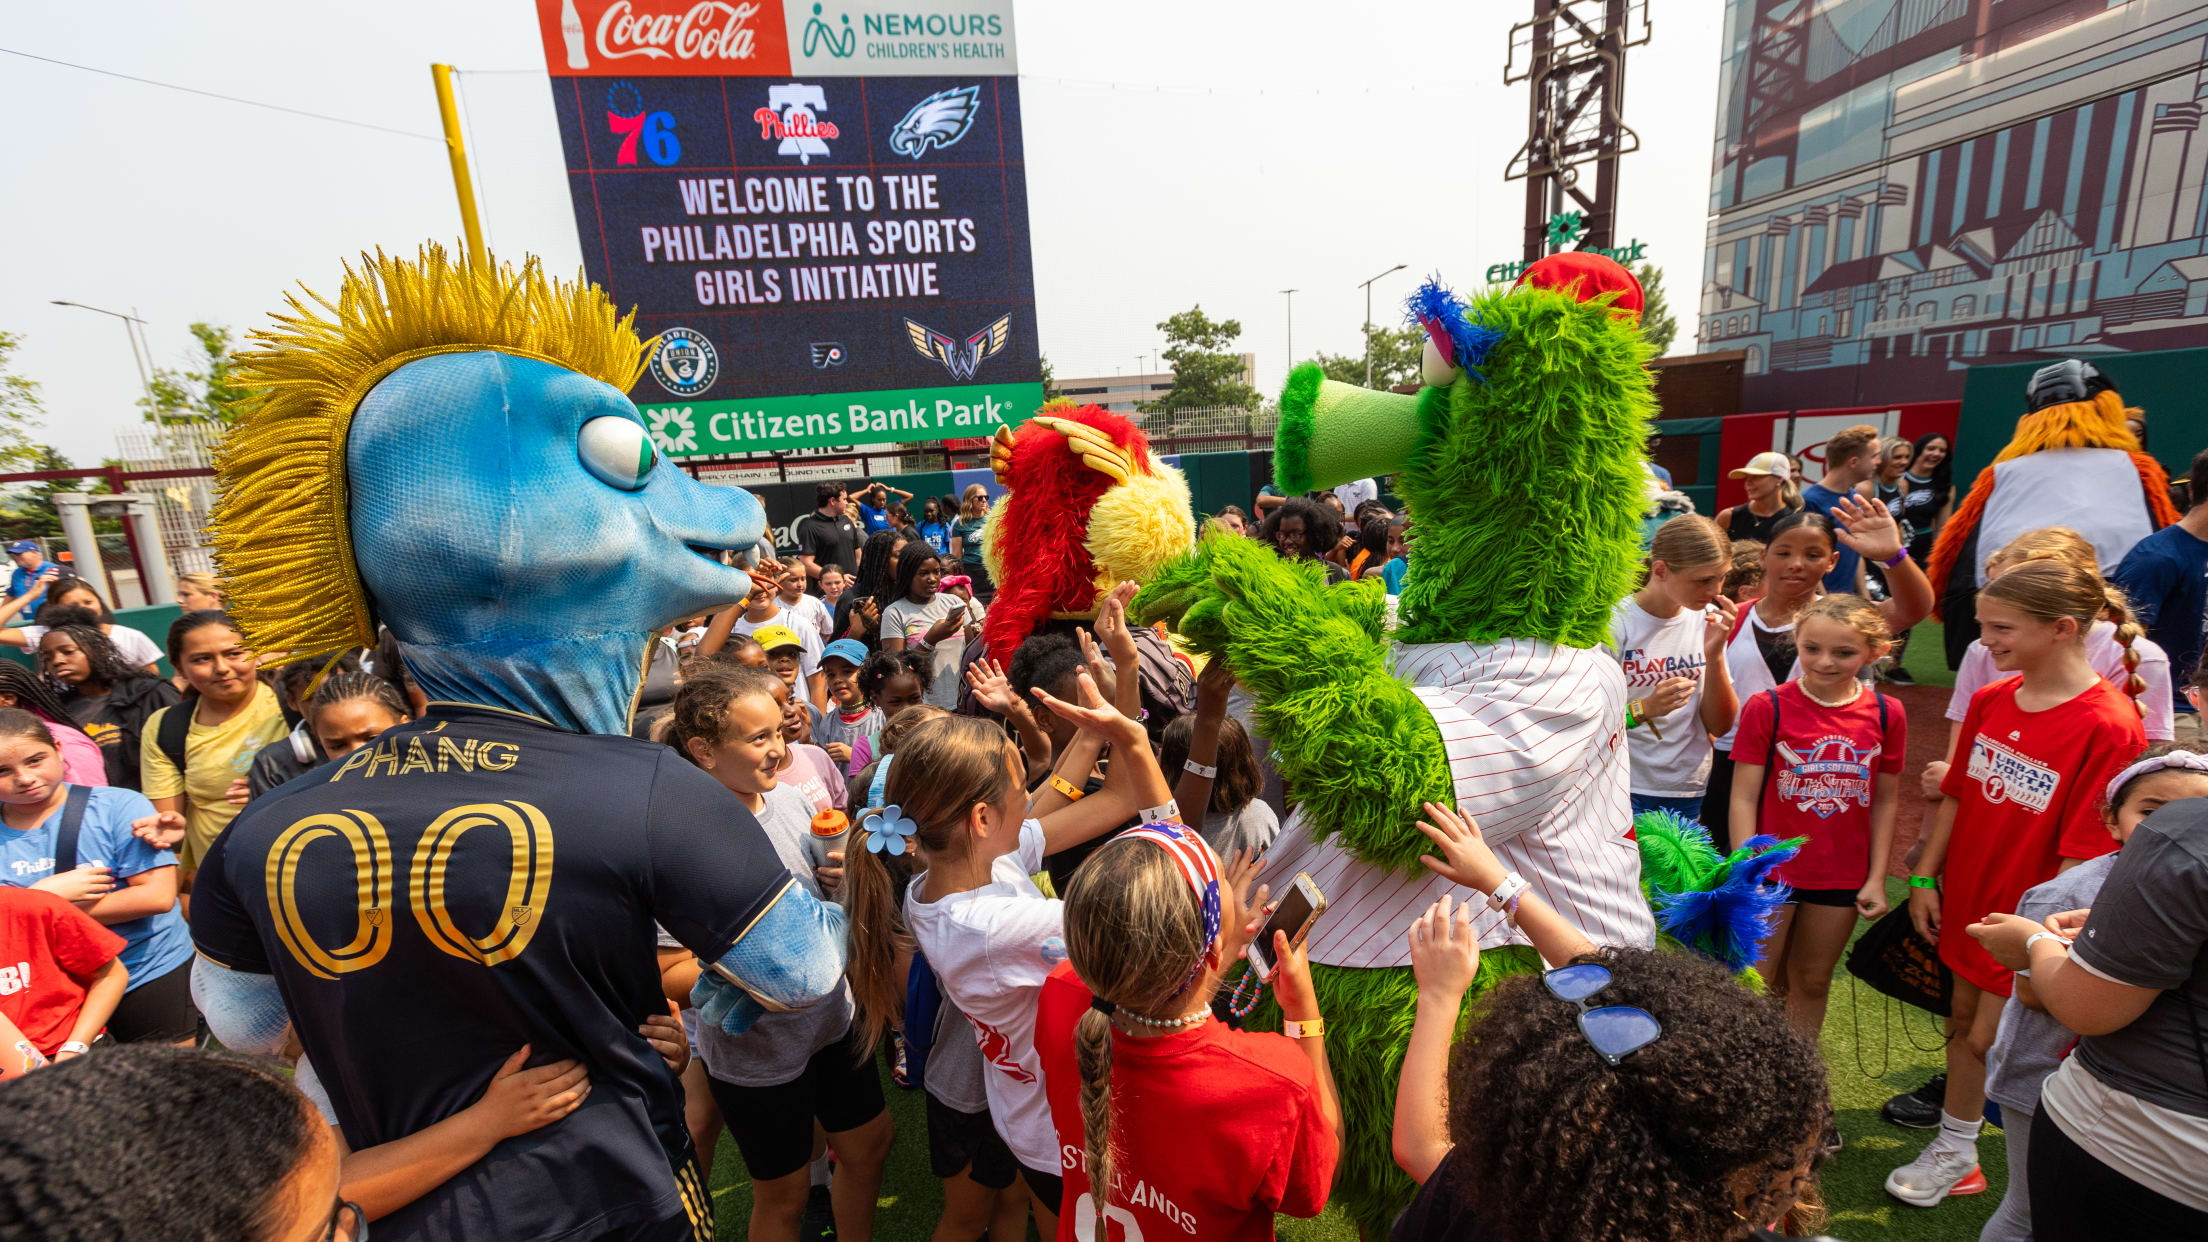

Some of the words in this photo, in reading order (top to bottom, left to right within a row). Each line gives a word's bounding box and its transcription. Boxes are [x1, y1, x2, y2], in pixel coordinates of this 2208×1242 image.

[596, 1, 760, 60] Coca-Cola
[863, 14, 1003, 36] NEMOURS
[866, 42, 950, 59] CHILDREN'S
[953, 42, 1005, 59] HEALTH
[608, 110, 681, 167] 76
[754, 107, 839, 140] Phillies
[679, 176, 831, 216] WELCOME
[836, 175, 876, 212] TO
[882, 174, 940, 210] THE
[641, 221, 860, 263] PHILADELPHIA
[866, 217, 977, 256] SPORTS
[694, 268, 782, 306] GIRLS
[789, 262, 940, 302] INITIATIVE
[708, 409, 843, 441] Citizens
[848, 399, 929, 433] Bank
[769, 468, 813, 477] GOUND
[821, 467, 838, 475] LTL
[329, 736, 520, 782] PHANG
[1802, 763, 1825, 774] GIRLS
[1827, 762, 1862, 774] SOFTBALL
[1995, 753, 2056, 784] URBAN
[1995, 760, 2052, 792] YOUTH
[1991, 768, 2049, 797] ACADEMY
[265, 800, 554, 981] 00
